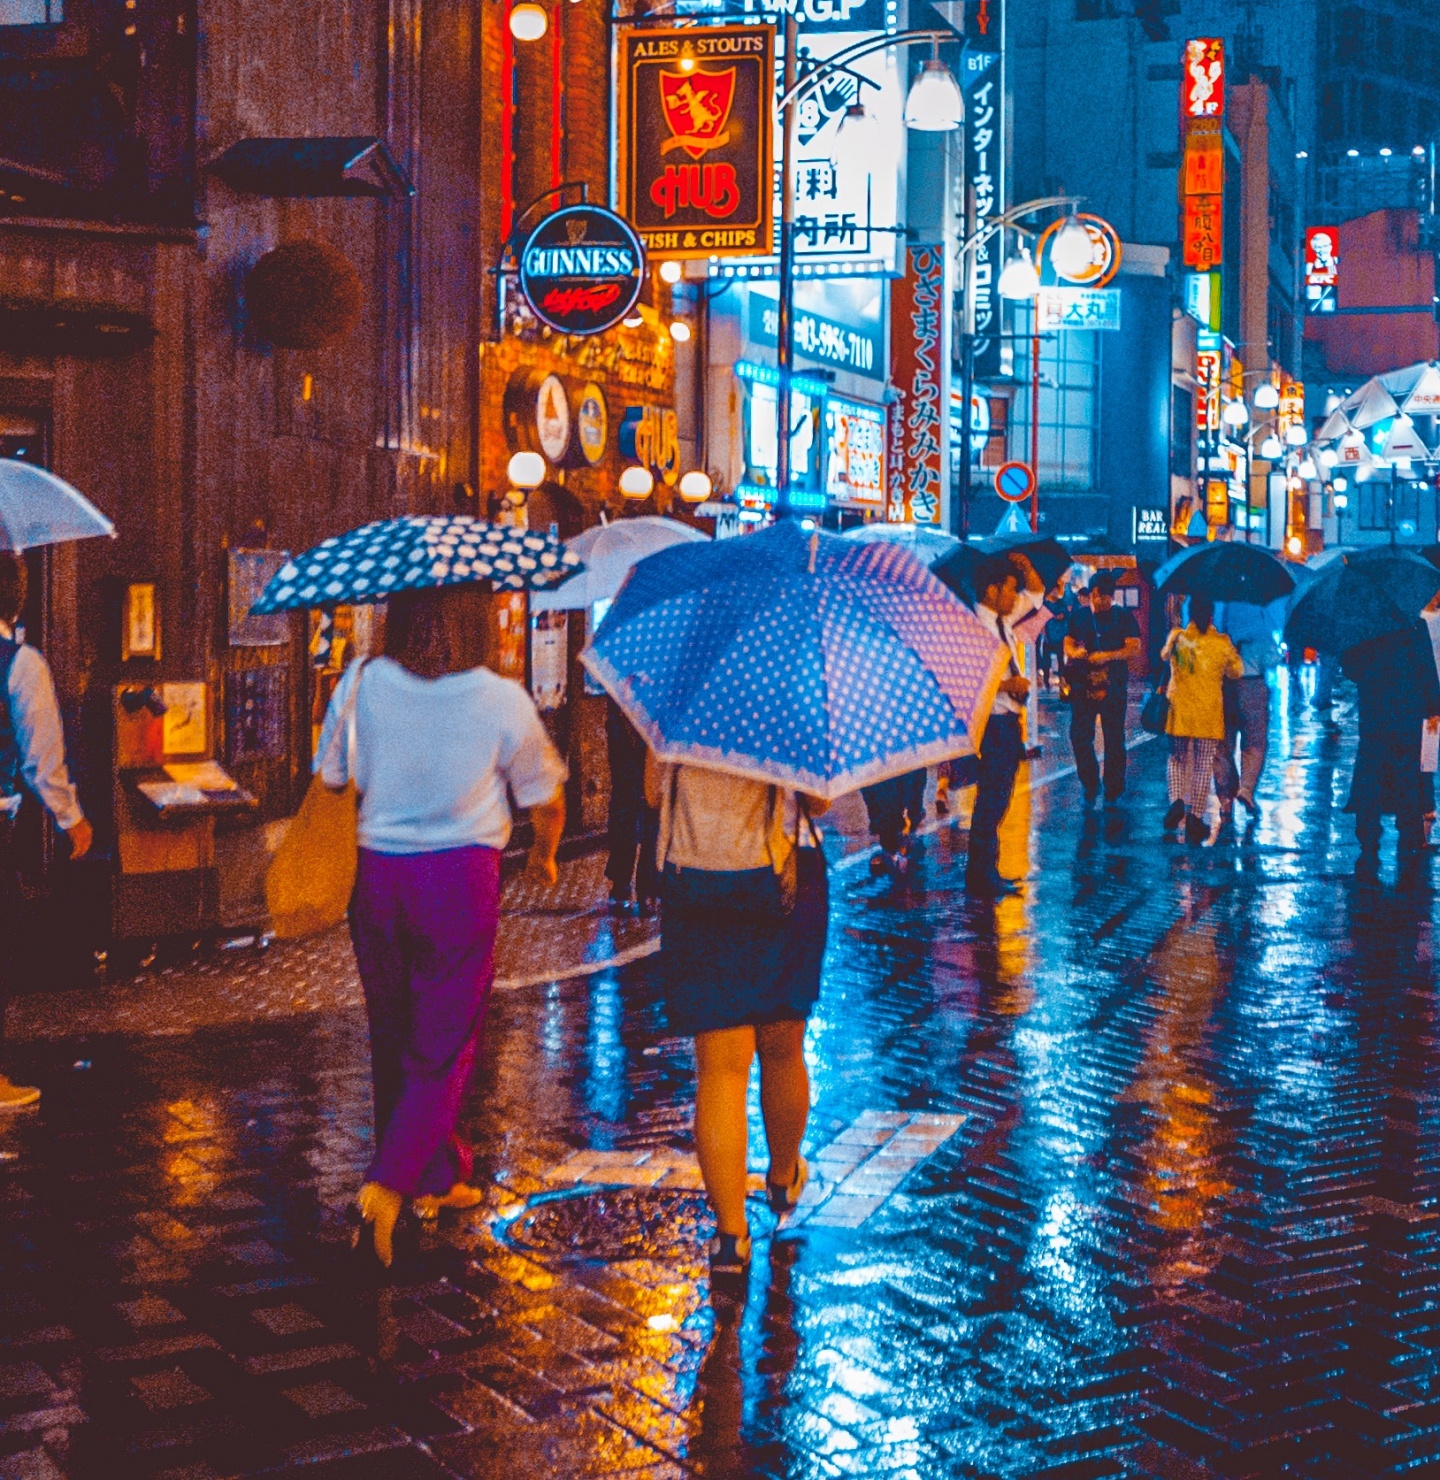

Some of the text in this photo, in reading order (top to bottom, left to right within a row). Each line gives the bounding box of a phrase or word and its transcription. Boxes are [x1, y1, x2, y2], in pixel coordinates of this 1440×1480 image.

[634, 37, 763, 57] ALES & STOUTS
[967, 54, 992, 71] B1F
[650, 162, 740, 218] HUB
[682, 232, 697, 248] &
[700, 230, 756, 247] CHIPS
[794, 213, 857, 247] 内所
[526, 248, 633, 277] GUINNESS
[909, 245, 942, 522] ひざまくらみみかき
[1141, 509, 1163, 522] BAR
[1138, 521, 1167, 534] REAL
